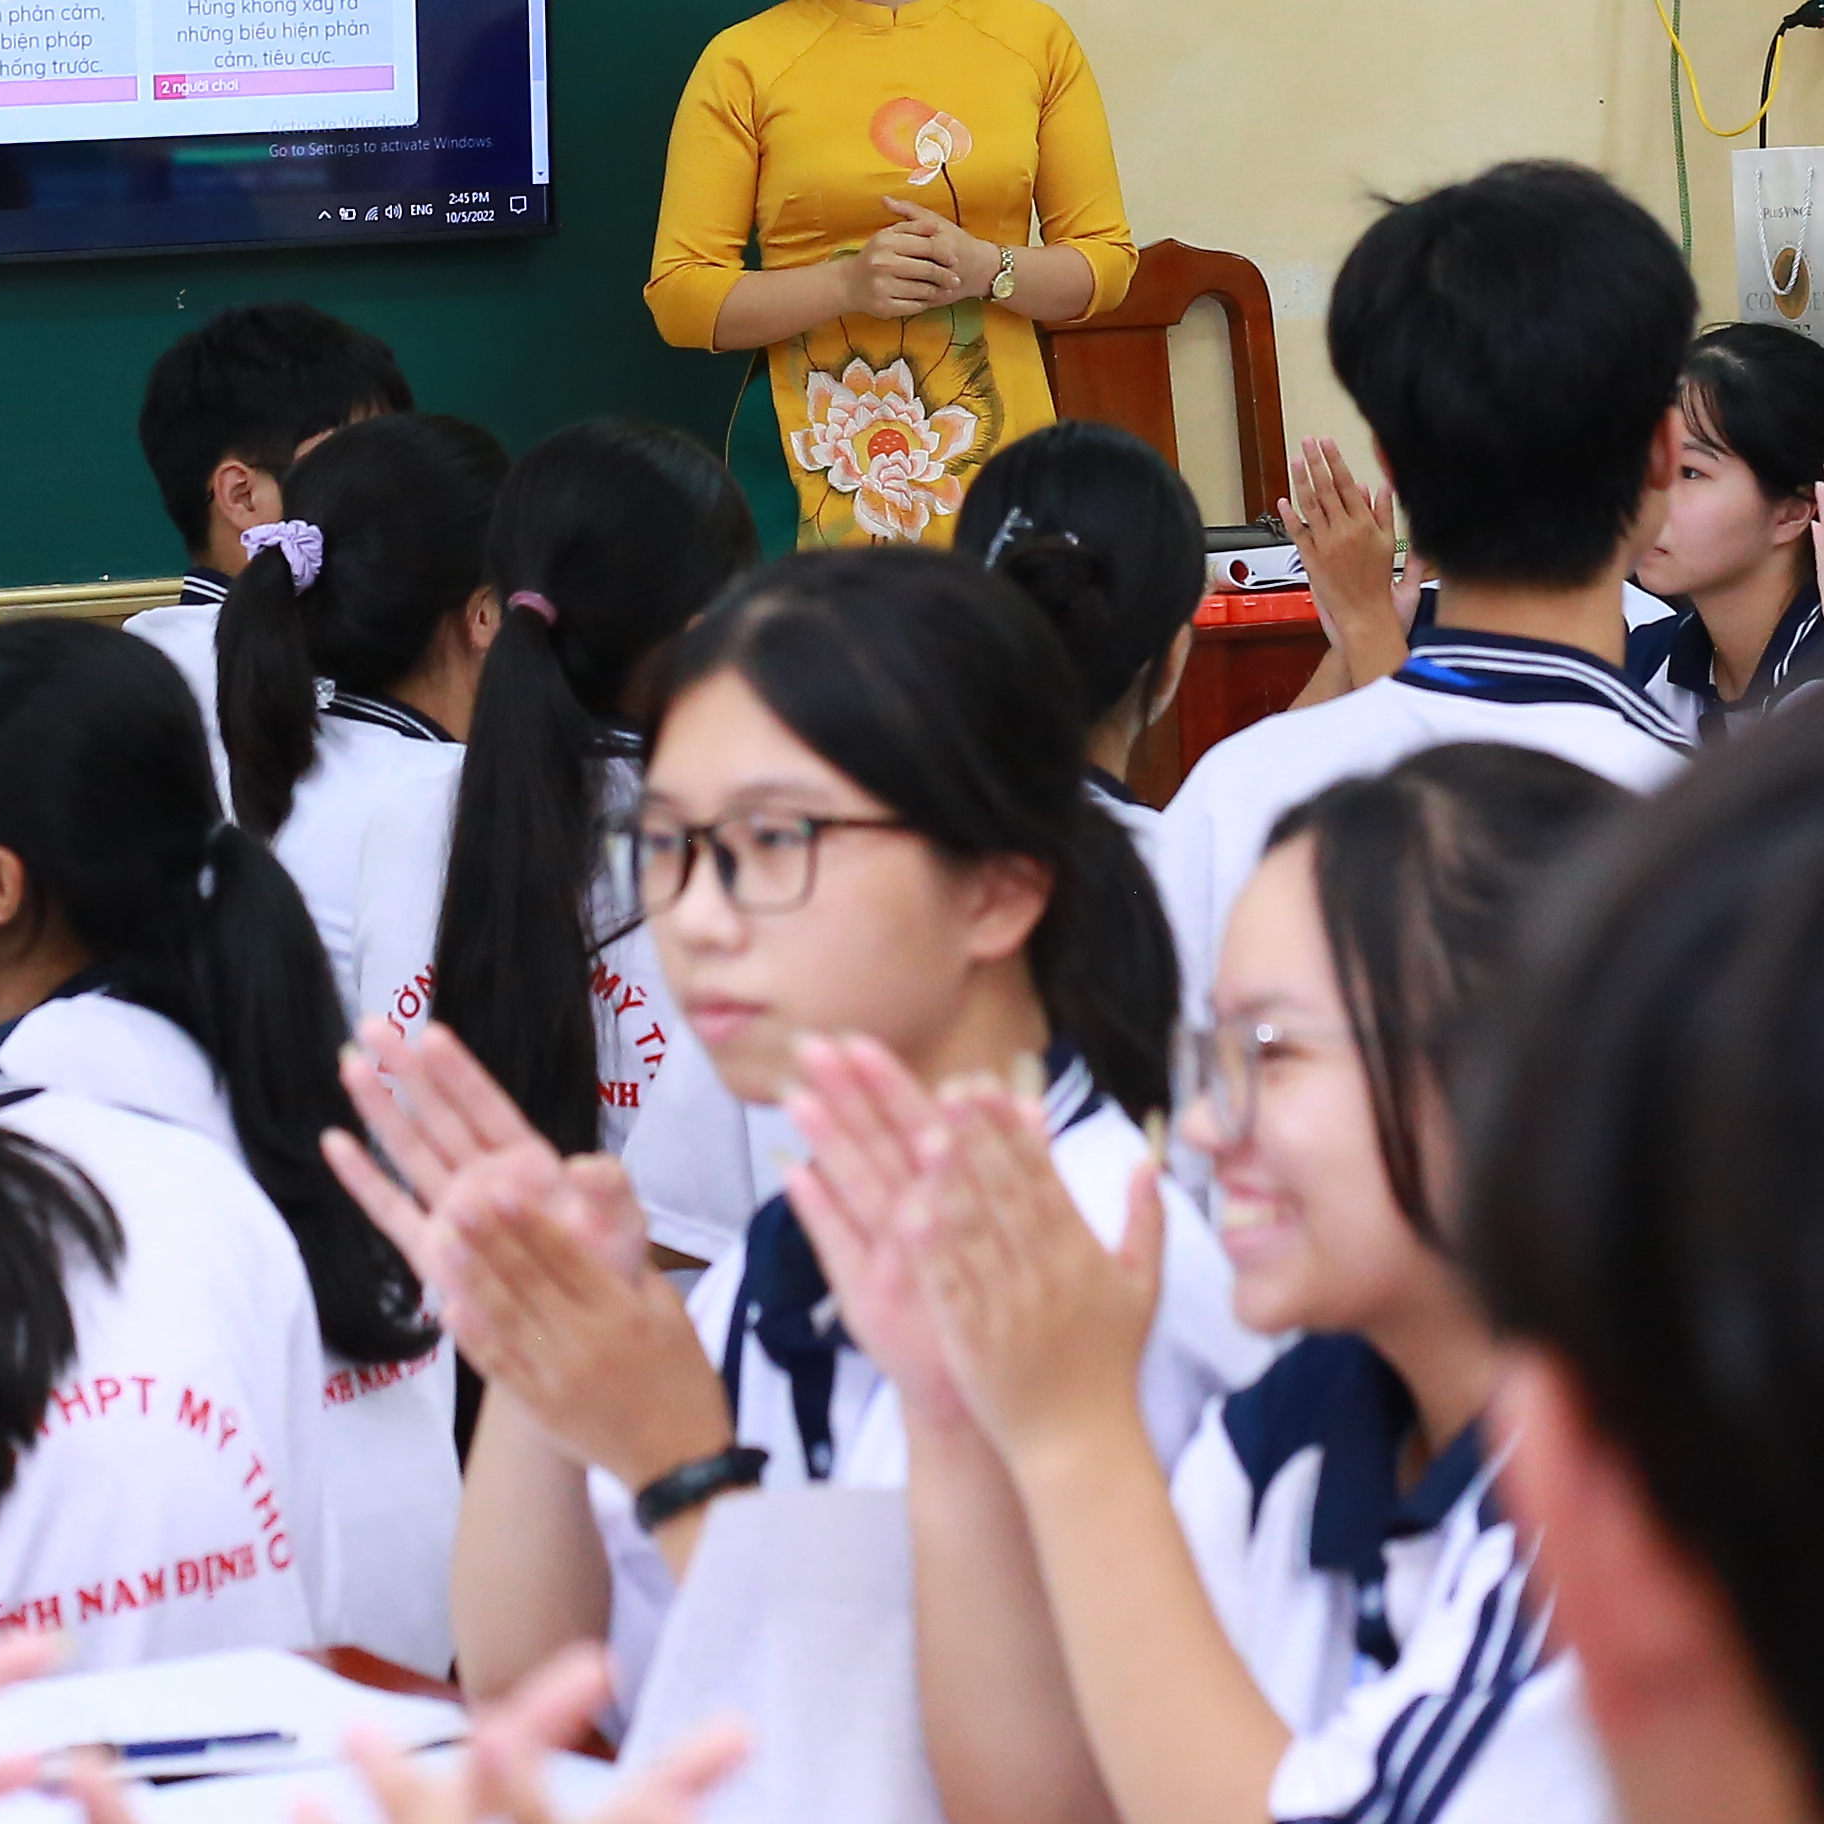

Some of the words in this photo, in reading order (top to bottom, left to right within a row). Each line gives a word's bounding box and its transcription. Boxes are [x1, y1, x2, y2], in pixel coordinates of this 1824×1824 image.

[9, 4, 55, 26] phản
[61, 3, 105, 22] cảm,
[269, 144, 288, 158] Go
[292, 144, 305, 156] to
[309, 142, 360, 157] Settings
[363, 141, 377, 153] to
[381, 139, 430, 152] activate
[449, 193, 470, 205] 2:45
[472, 192, 490, 203] PM
[410, 204, 433, 216] ENG
[445, 210, 495, 224] 10/5/2022
[34, 1377, 156, 1435] HPT
